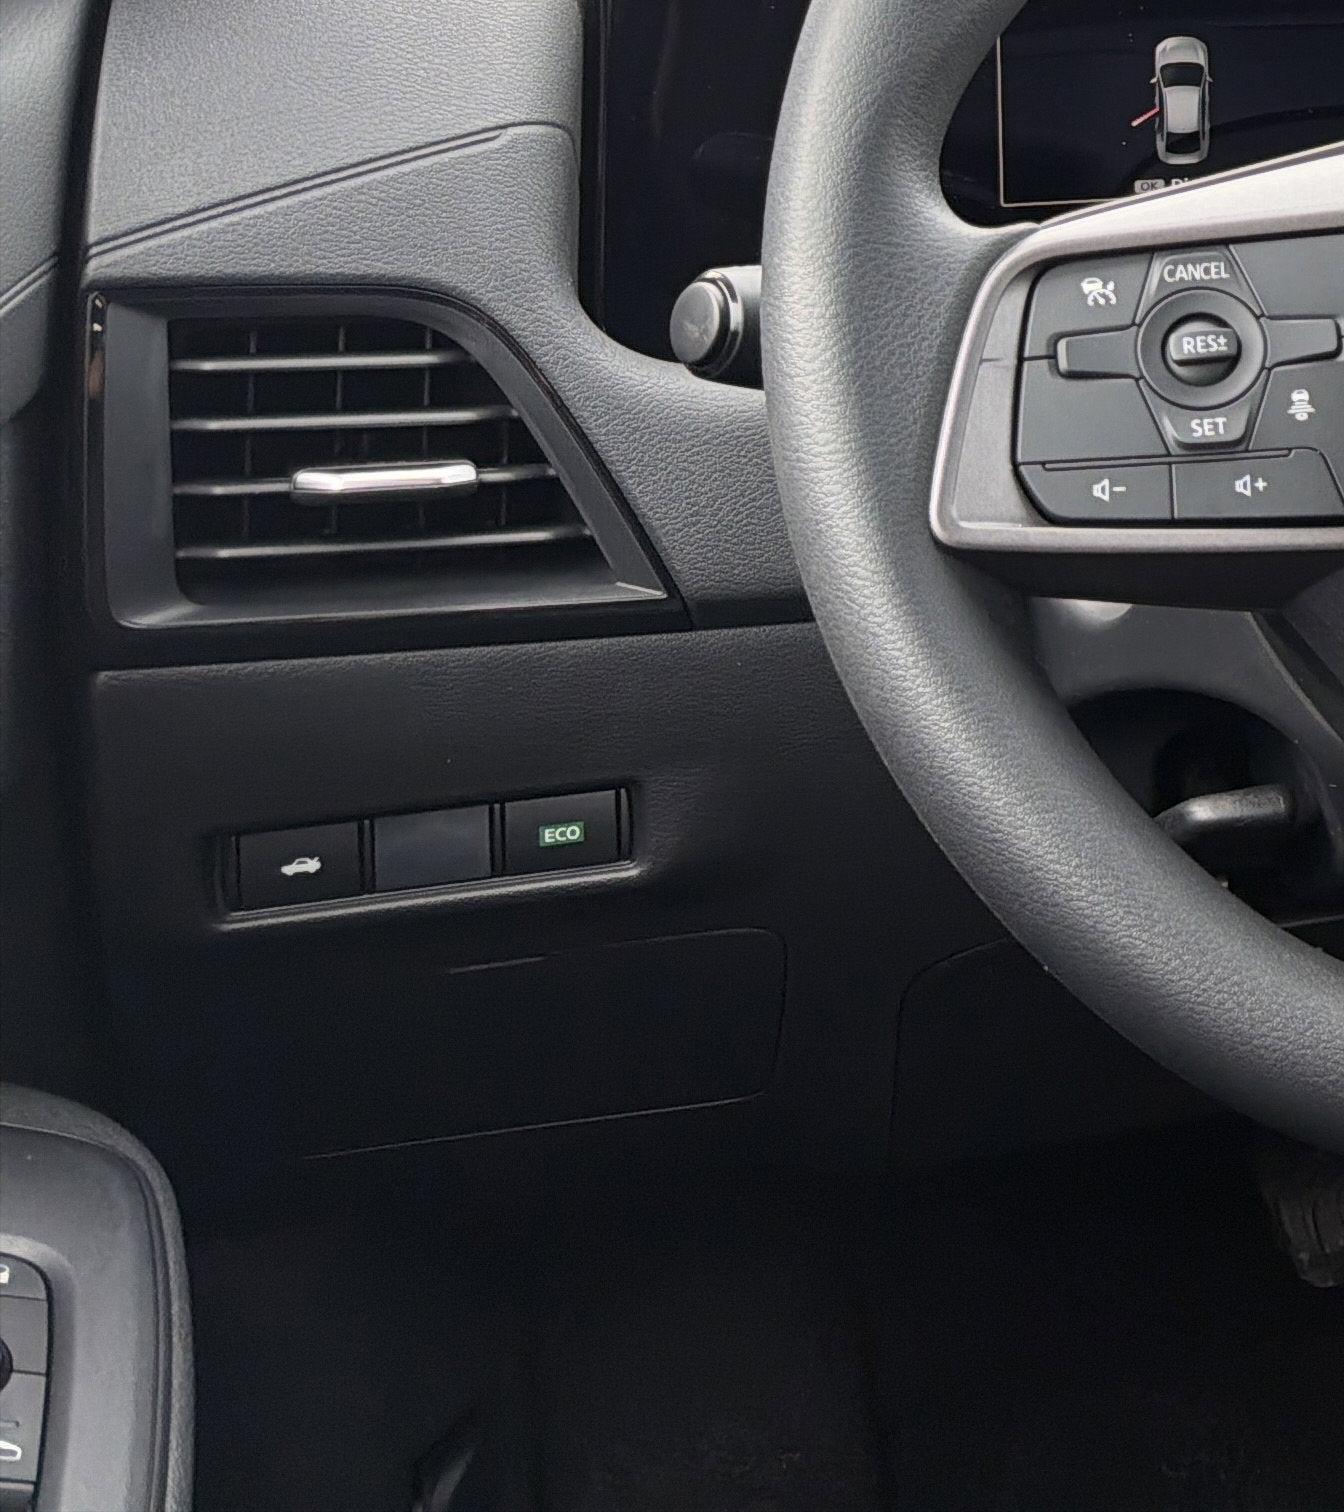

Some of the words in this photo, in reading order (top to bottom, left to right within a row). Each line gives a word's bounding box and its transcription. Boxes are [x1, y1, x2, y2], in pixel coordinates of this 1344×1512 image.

[1162, 261, 1230, 283] CANCEL
[1190, 416, 1227, 437] SET
[544, 825, 580, 844] ECO
